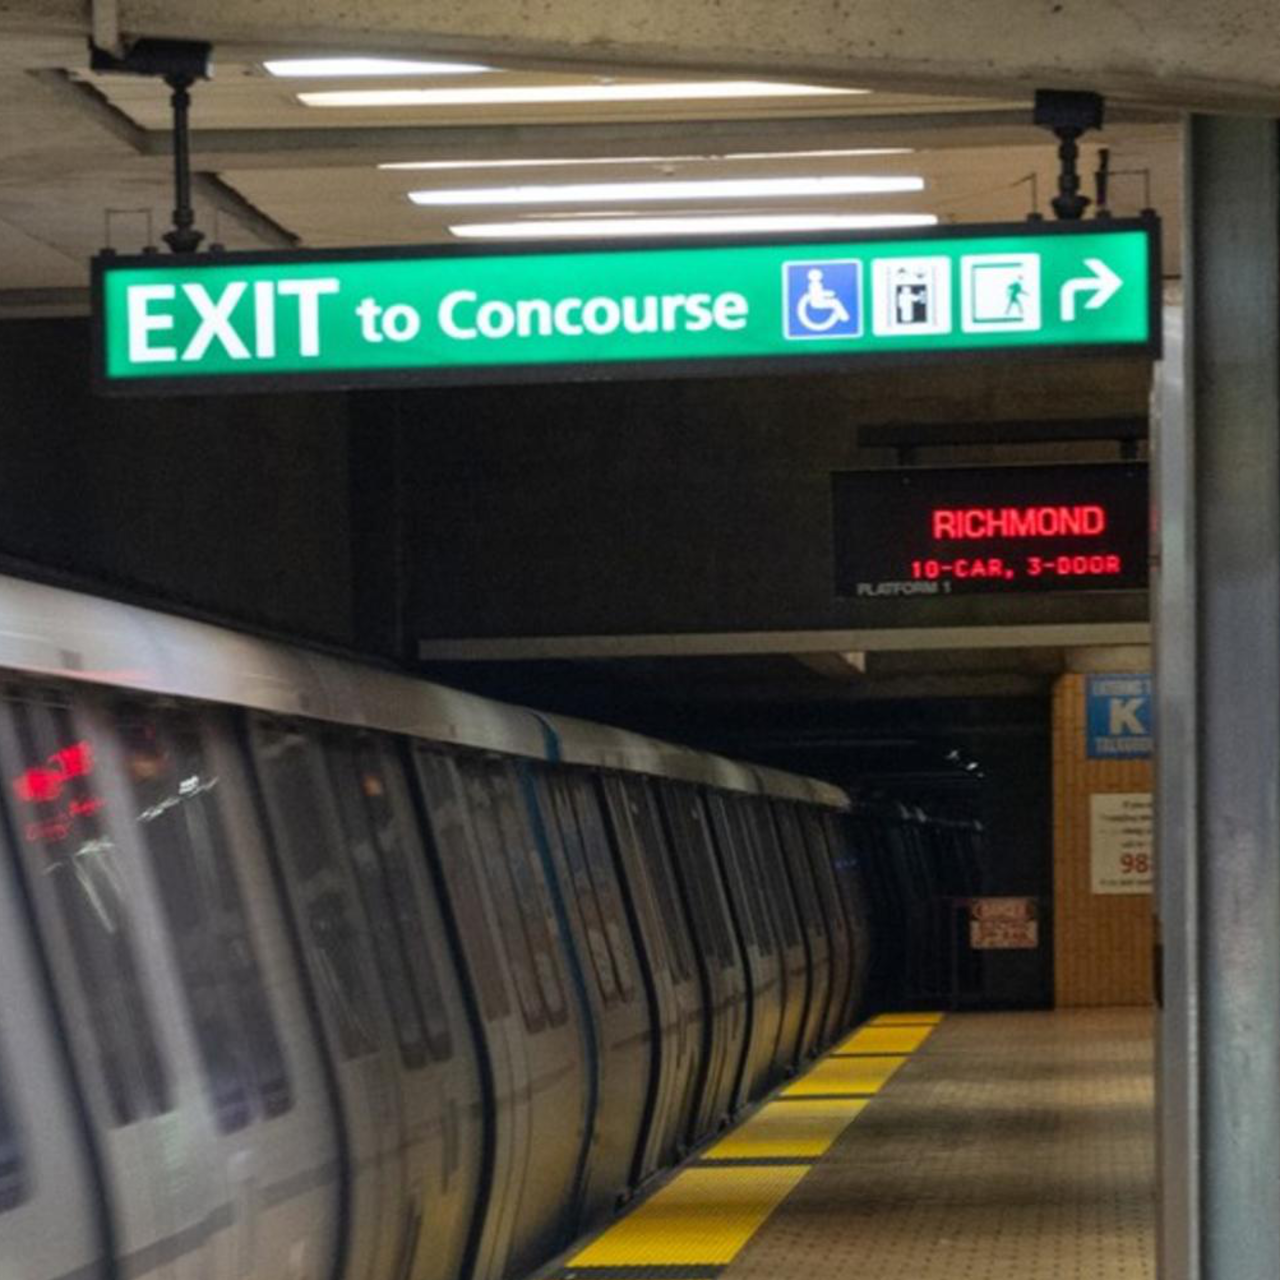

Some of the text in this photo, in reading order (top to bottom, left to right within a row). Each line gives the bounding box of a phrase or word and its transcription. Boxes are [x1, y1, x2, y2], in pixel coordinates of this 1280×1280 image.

[126, 277, 749, 364] EXIT to Concourse
[932, 505, 1105, 539] RICHMOND
[911, 554, 1121, 580] 10-CAR, 3-DOOR
[856, 581, 938, 596] PLATFORM
[1109, 697, 1146, 735] K
